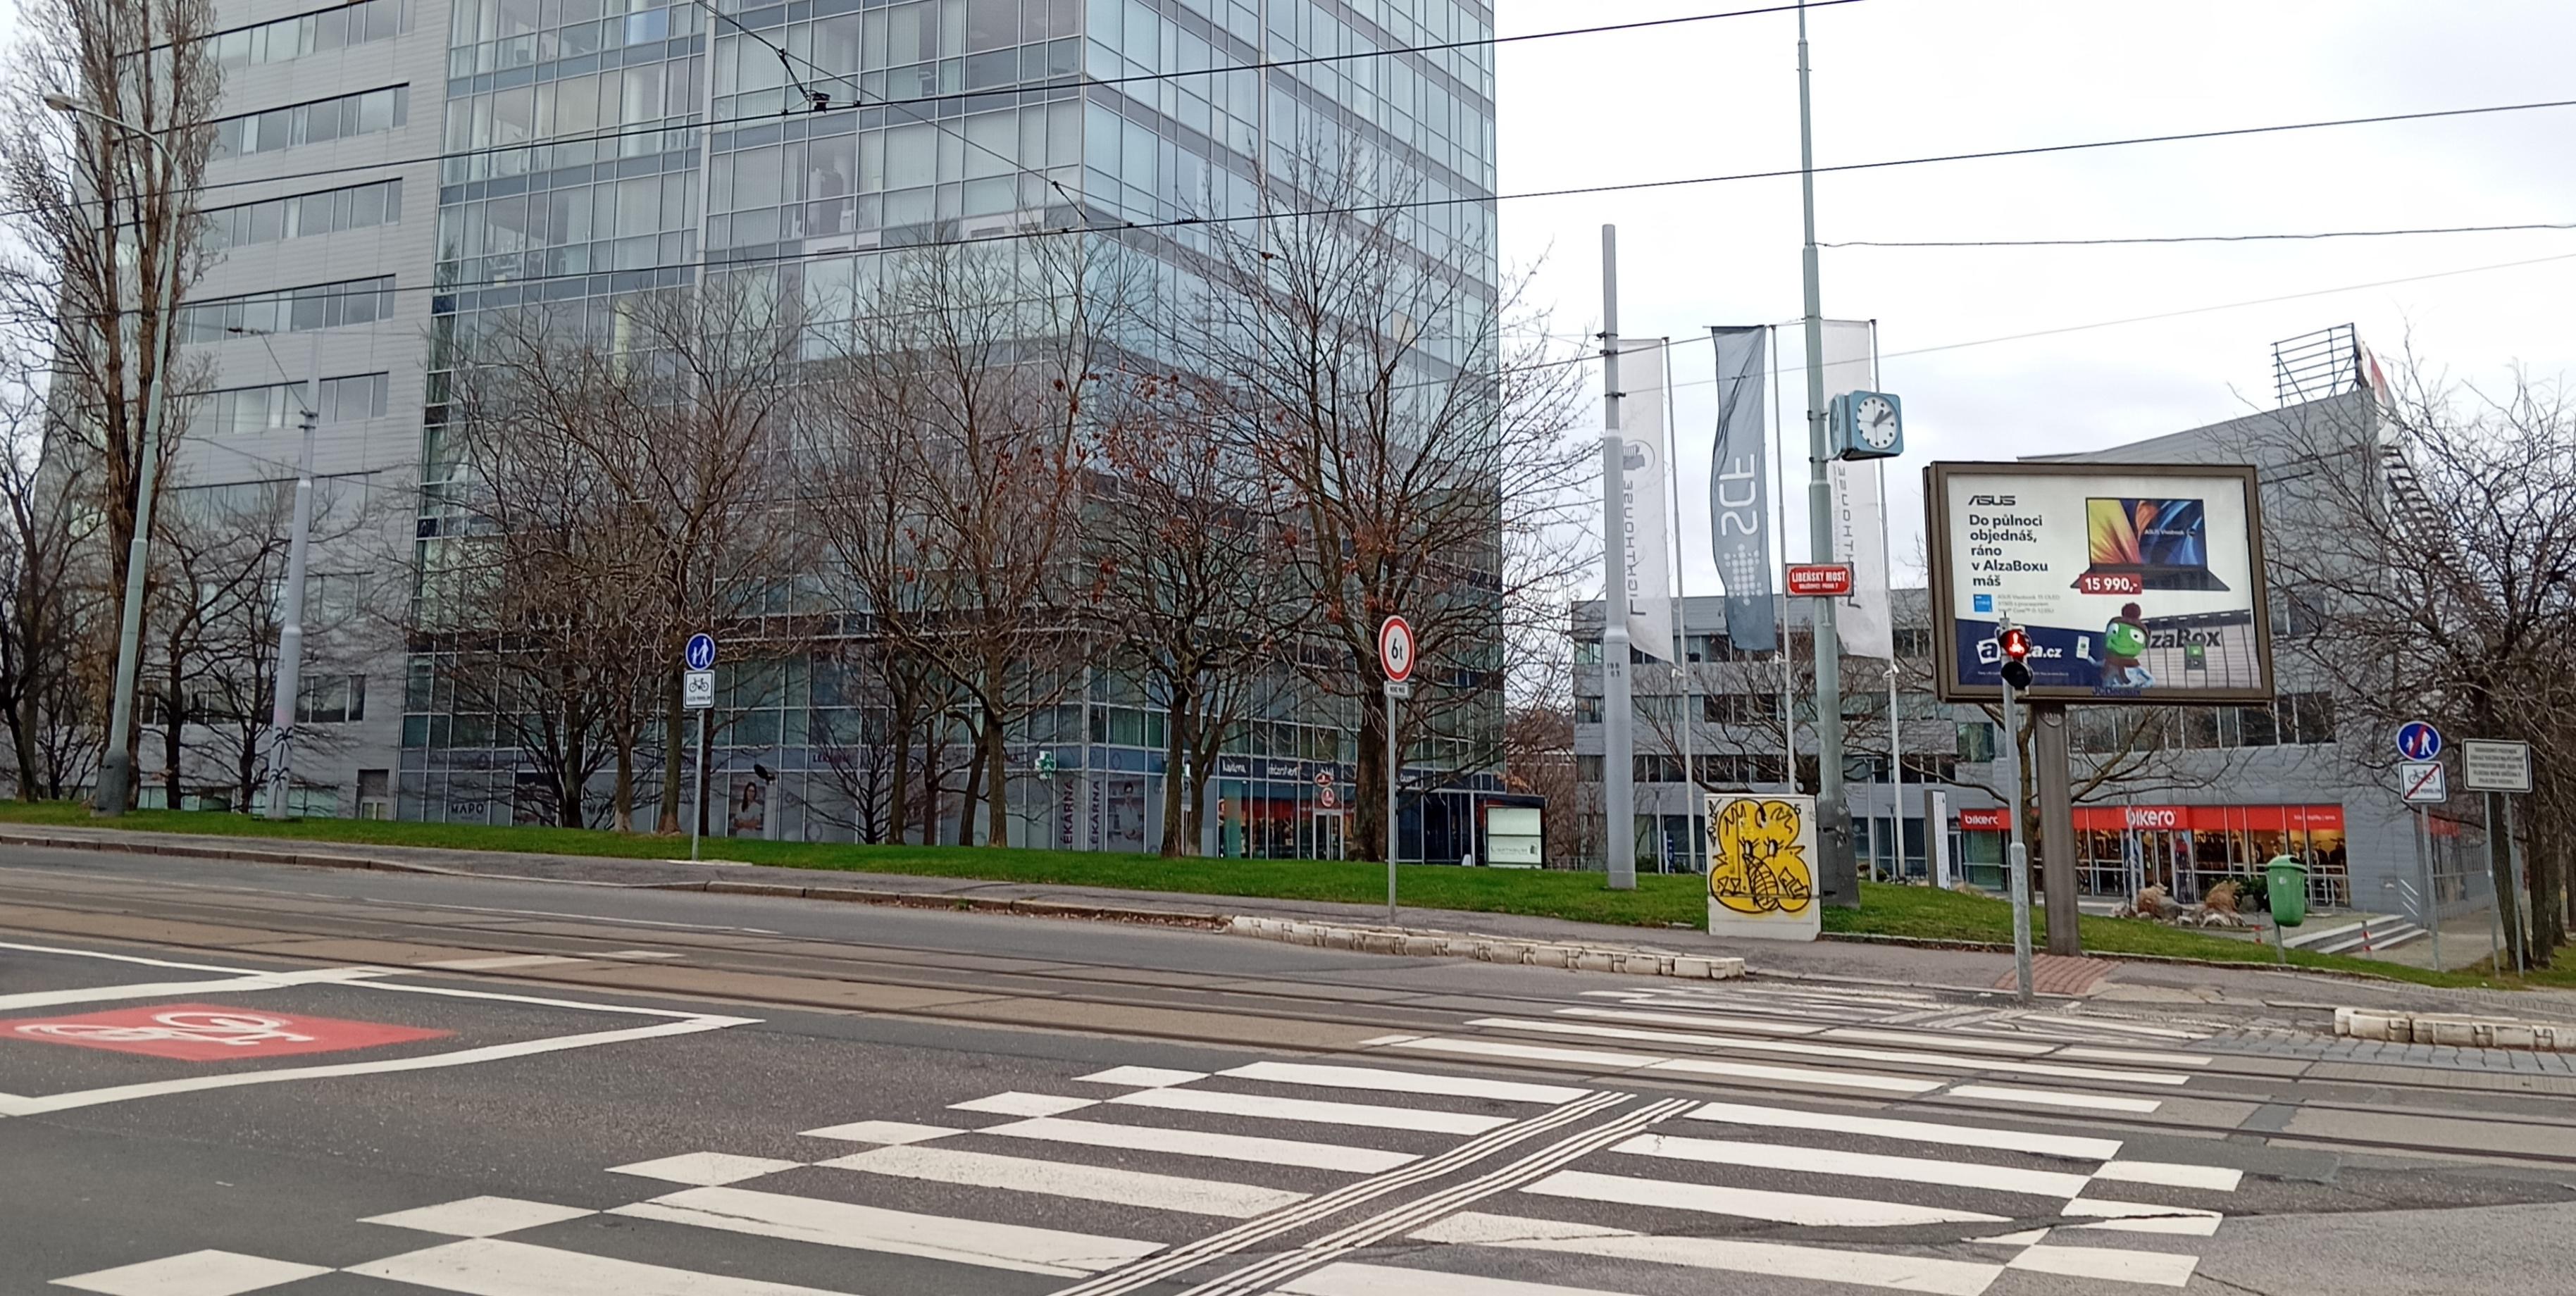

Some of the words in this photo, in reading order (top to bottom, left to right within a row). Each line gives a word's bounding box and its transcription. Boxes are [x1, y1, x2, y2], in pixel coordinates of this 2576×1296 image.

[1968, 495, 2016, 506] ASUS
[1970, 514, 1989, 525] Do
[1993, 514, 2043, 528] půlnoci
[1970, 529, 2037, 544] objednáš,
[1971, 544, 2002, 556] ráno
[1972, 562, 1980, 571] v
[1983, 559, 2048, 571] AlzaBoxu
[1791, 571, 1824, 582] LIBEŇSKÝ
[1825, 571, 1846, 582] MOST
[1973, 575, 2001, 586] máš
[2085, 578, 2100, 590] 15
[2103, 578, 2138, 592] 990,-
[1981, 642, 2062, 659] aa.cz
[452, 803, 484, 814] MAPO
[2125, 808, 2174, 826] bikero
